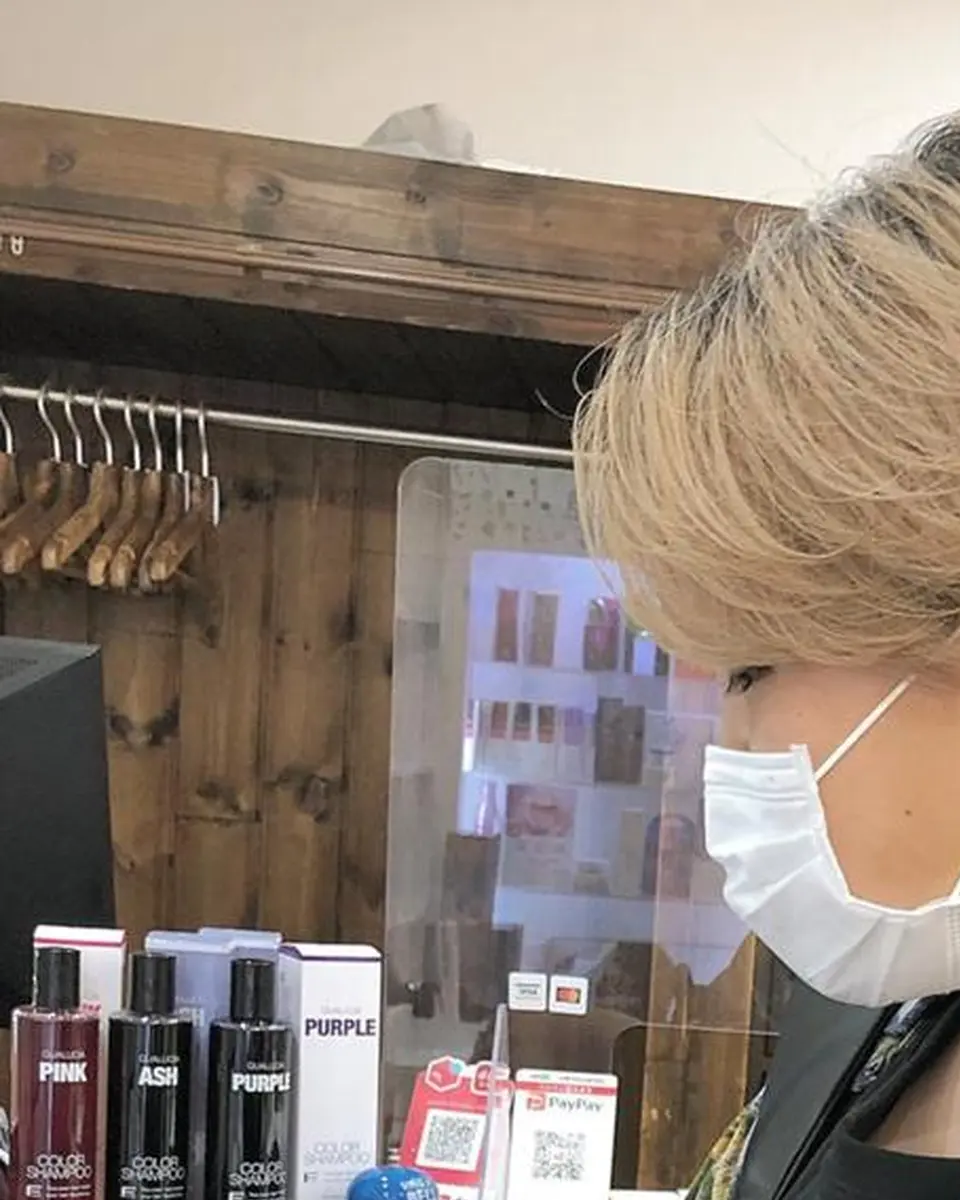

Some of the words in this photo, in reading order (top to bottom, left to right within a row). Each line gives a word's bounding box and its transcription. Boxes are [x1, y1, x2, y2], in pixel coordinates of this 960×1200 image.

[304, 1018, 376, 1036] PURPLE
[39, 1061, 87, 1083] PINK
[138, 1066, 179, 1087] ASH
[549, 1095, 603, 1112] PayPay
[37, 1154, 86, 1168] COLOR
[132, 1155, 179, 1169] COLOR
[26, 1165, 92, 1180] SHAMPOO
[121, 1167, 185, 1181] SHAMPOO
